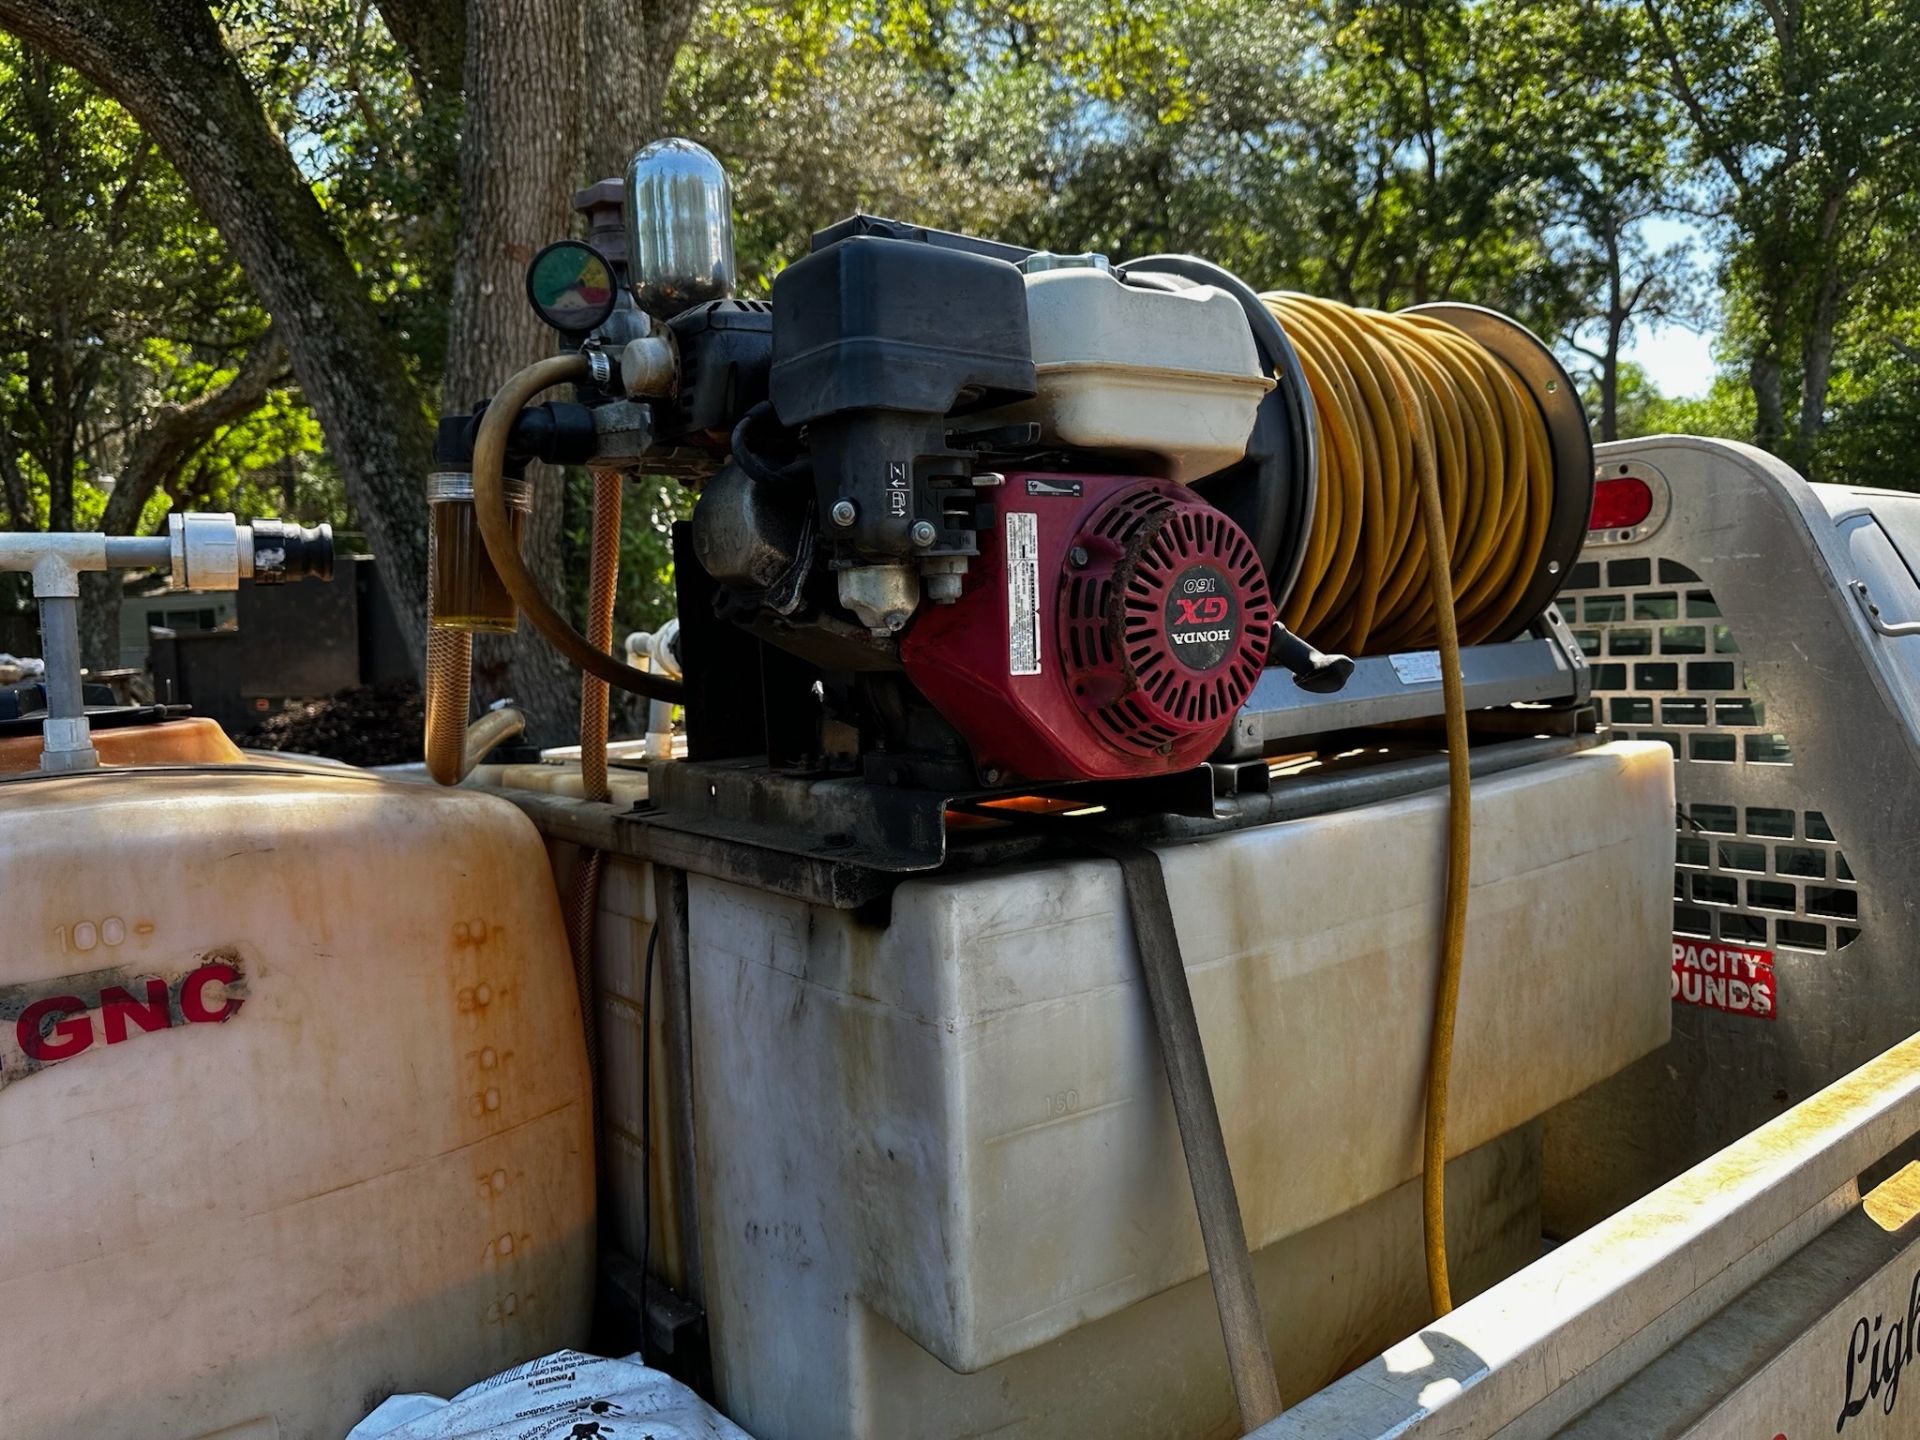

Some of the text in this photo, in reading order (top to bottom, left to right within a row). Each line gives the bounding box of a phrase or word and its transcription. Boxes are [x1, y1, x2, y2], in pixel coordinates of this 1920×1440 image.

[1184, 578, 1216, 594] 160
[1174, 597, 1228, 625] GX
[1171, 628, 1231, 645] HONDA
[53, 915, 127, 954] 100
[1672, 942, 1762, 979] PACITY
[16, 963, 246, 1061] GNC
[1045, 1088, 1080, 1120] 150
[527, 1371, 577, 1389] Possum's
[515, 1404, 555, 1419] Solutions
[546, 1412, 578, 1426] Control
[517, 1422, 547, 1440] Supply
